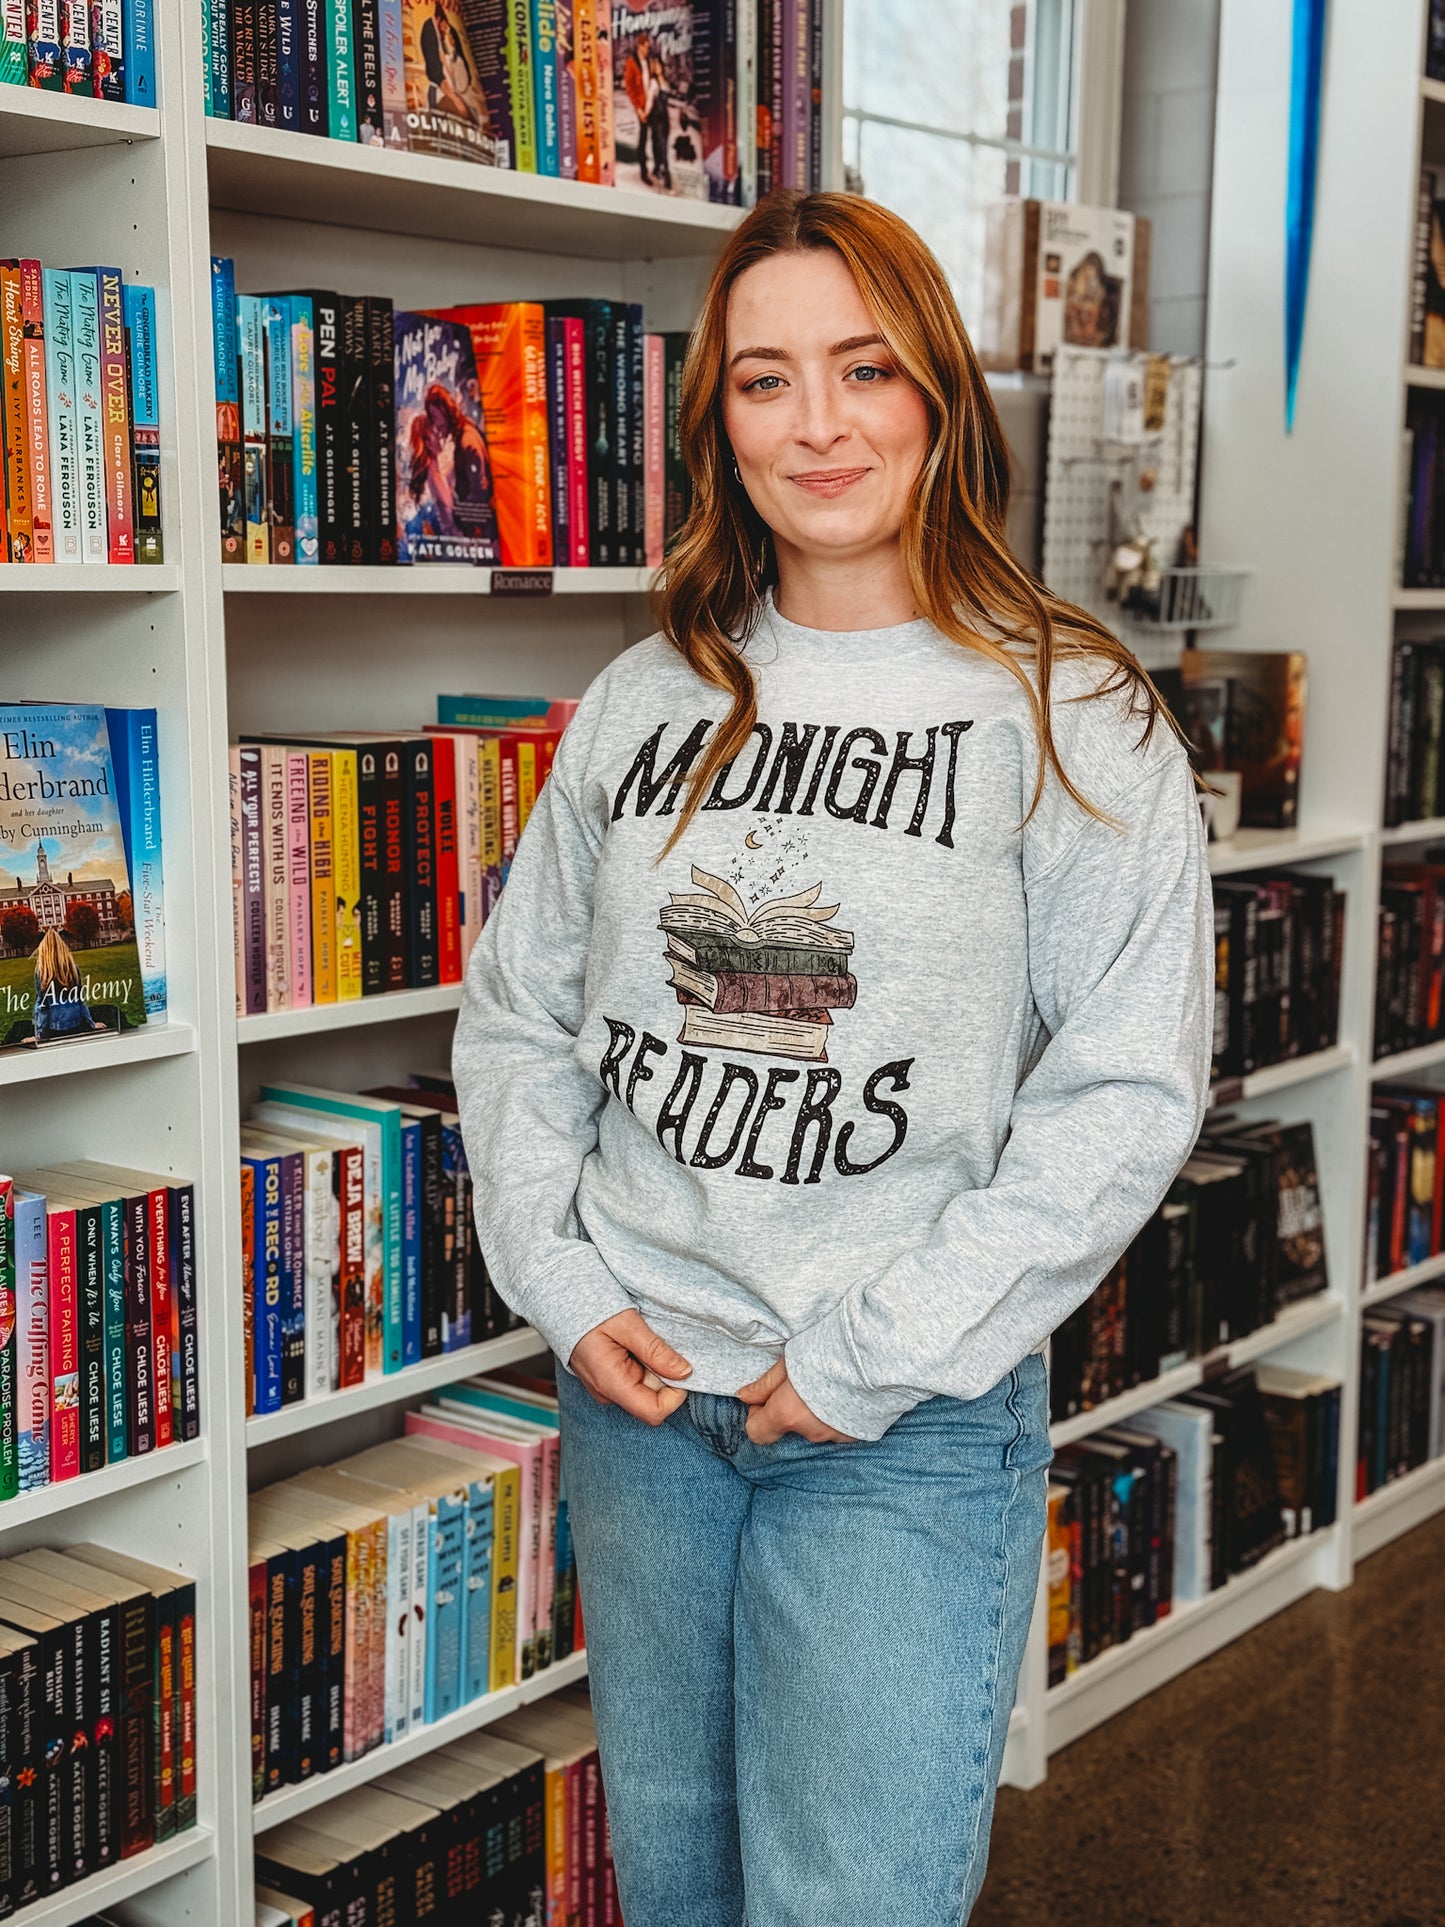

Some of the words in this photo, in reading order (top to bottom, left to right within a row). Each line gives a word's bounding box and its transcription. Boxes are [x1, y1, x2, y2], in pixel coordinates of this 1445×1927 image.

[73, 4, 84, 45] CENTER
[106, 11, 119, 54] CENTER
[219, 13, 227, 51] REALLY
[279, 16, 292, 55] WILD
[306, 0, 318, 61] STITCHES
[335, 0, 348, 55] SPOILER
[362, 11, 373, 39] THE
[581, 20, 592, 66] LAST
[337, 60, 349, 108] ALERT
[363, 44, 376, 88] FEELS
[543, 65, 554, 100] Nora
[406, 113, 464, 138] OLIVIA
[544, 103, 556, 147] Dahlia
[583, 101, 594, 139] LIST
[4, 279, 20, 322] Heart
[54, 280, 69, 302] The
[78, 282, 95, 303] The
[215, 279, 225, 321] LAURIE
[53, 304, 71, 348] Mating
[78, 305, 97, 349] Mating
[102, 274, 122, 355] NEVER
[135, 312, 144, 348] LAURIE
[320, 308, 336, 358] PEN
[616, 321, 625, 348] THE
[7, 327, 23, 375] Strings
[29, 345, 39, 369] ALL
[142, 307, 151, 378] GINGERBREAD
[217, 324, 227, 375] GILMORE
[299, 333, 312, 371] Love
[56, 351, 75, 385] Game
[81, 353, 99, 386] Game
[136, 353, 145, 400] GILMORE
[321, 367, 336, 407] PAL
[616, 353, 626, 413] WRONG
[13, 398, 21, 420] IVY
[31, 373, 42, 415] ROADS
[107, 363, 125, 424] OVER
[144, 380, 153, 419] BAKERY
[33, 418, 43, 450] LEAD
[59, 415, 68, 451] LANA
[83, 416, 93, 451] LANA
[114, 435, 123, 469] Clare
[301, 408, 314, 476] Afterlife
[616, 417, 626, 466] HEART
[15, 427, 25, 502] FAIRBANKS
[35, 453, 44, 470] TO
[36, 473, 46, 511] ROME
[60, 457, 71, 529] FERGUSON
[85, 457, 97, 529] FERGUSON
[115, 471, 126, 520] Gilmore
[326, 449, 335, 523] GEISSINGER
[352, 449, 360, 528] GEISSINGER
[380, 447, 389, 526] GEISSINGER
[408, 543, 442, 556] KATE
[494, 573, 551, 589] Romance
[3, 730, 56, 759] Elin
[141, 726, 150, 754] Elin
[246, 770, 258, 791] ALL
[271, 763, 282, 776] IT
[312, 759, 330, 818] RIDING
[611, 718, 973, 849] MDNIGHT
[142, 760, 155, 850] Hilderbrand
[246, 793, 257, 827] YOUR
[271, 782, 283, 819] ENDS
[289, 758, 305, 823] FREEING
[339, 778, 350, 827] HELENA
[11, 809, 22, 817] and
[37, 808, 64, 817] daughter
[21, 820, 103, 838] Cunningham
[273, 826, 284, 861] WITH
[363, 805, 377, 870] FIGHT
[386, 800, 400, 873] HONOR
[416, 791, 430, 887] PROTECT
[248, 832, 260, 892] PERFECTS
[273, 866, 285, 884] US
[292, 846, 308, 885] WILD
[314, 841, 331, 879] HIGH
[340, 830, 351, 893] HUNTING
[142, 862, 152, 917] Five-Star
[250, 901, 261, 943] COLLEEN
[275, 898, 284, 940] COLLEEN
[143, 922, 155, 968] Weekend
[252, 946, 262, 985] HOOVER
[39, 978, 133, 1009] Academy
[601, 1016, 914, 1184] READERS
[265, 1163, 279, 1206] FOR
[292, 1168, 303, 1210] KILLER
[347, 1154, 361, 1206] DEJA
[33, 1217, 42, 1240] LEE
[60, 1222, 69, 1232] A
[134, 1204, 144, 1232] WITH
[154, 1195, 165, 1264] EVERYTHING
[180, 1195, 190, 1223] EVER
[390, 1203, 400, 1241] LITTLE
[86, 1218, 97, 1247] ONLY
[109, 1206, 119, 1255] ALWAYS
[135, 1237, 145, 1260] YOU
[181, 1226, 191, 1259] AFTER
[348, 1211, 363, 1263] BREW
[30, 1256, 48, 1297] The
[60, 1236, 72, 1303] PERFECT
[87, 1252, 98, 1286] WHEN
[109, 1259, 122, 1284] Only
[390, 1247, 400, 1267] TOO
[108, 1289, 123, 1312] You
[134, 1265, 147, 1304] Forever
[180, 1262, 193, 1300] Always
[292, 1251, 303, 1309] ROMANCE
[390, 1272, 401, 1324] FAMILIAR
[26, 1301, 48, 1378] Cuffing
[88, 1311, 100, 1328] Us
[62, 1310, 73, 1371] PAIRING
[156, 1335, 166, 1376] CHLOE
[184, 1334, 194, 1375] CHLOE
[1, 1349, 13, 1409] PARADISE
[88, 1361, 99, 1402] CHLOE
[111, 1347, 121, 1387] CHLOE
[136, 1346, 147, 1386] CHLOE
[31, 1382, 49, 1445] Game
[112, 1393, 123, 1427] LIESE
[137, 1392, 148, 1425] LIESE
[157, 1380, 168, 1414] LIESE
[185, 1379, 196, 1412] LIESE
[2, 1413, 13, 1466] PROBLEM
[61, 1416, 69, 1445] LISTER
[67, 1413, 75, 1445] SHERYL
[89, 1407, 99, 1442] LIESE
[270, 1575, 284, 1603] SOUL
[100, 1619, 110, 1684] RADIANT
[124, 1606, 145, 1684] REEL
[269, 1605, 284, 1674] SEARCHING
[45, 1671, 55, 1702] RUIN
[54, 1650, 63, 1715] MIDNIGHT
[100, 1688, 110, 1714] SIN
